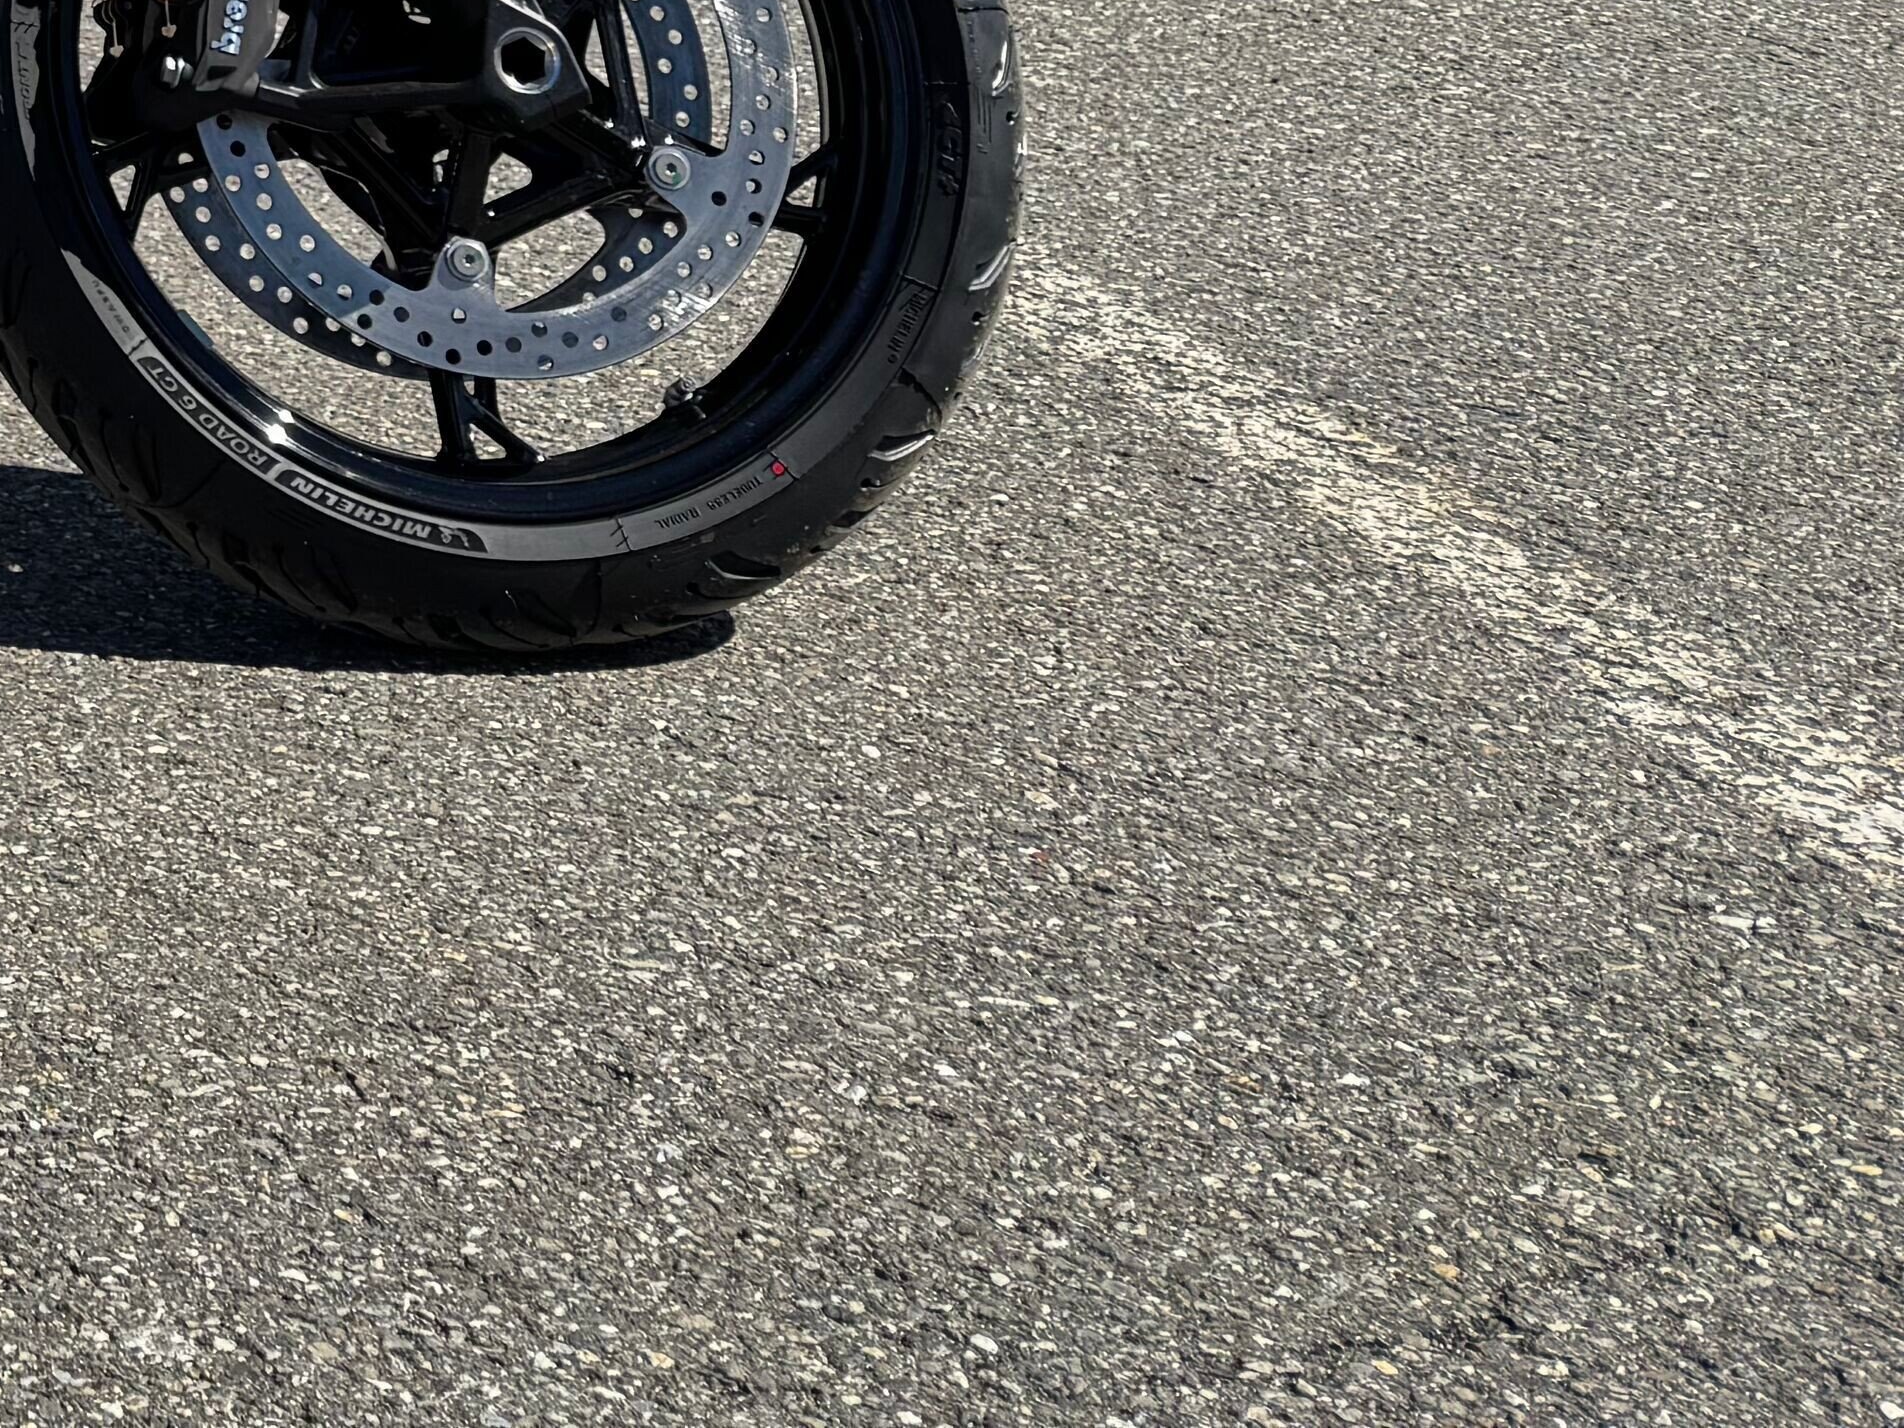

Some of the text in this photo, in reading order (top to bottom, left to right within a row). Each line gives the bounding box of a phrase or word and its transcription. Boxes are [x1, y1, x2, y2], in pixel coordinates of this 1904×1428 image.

[145, 365, 432, 540] MICHELIN ROAD 6 GT
